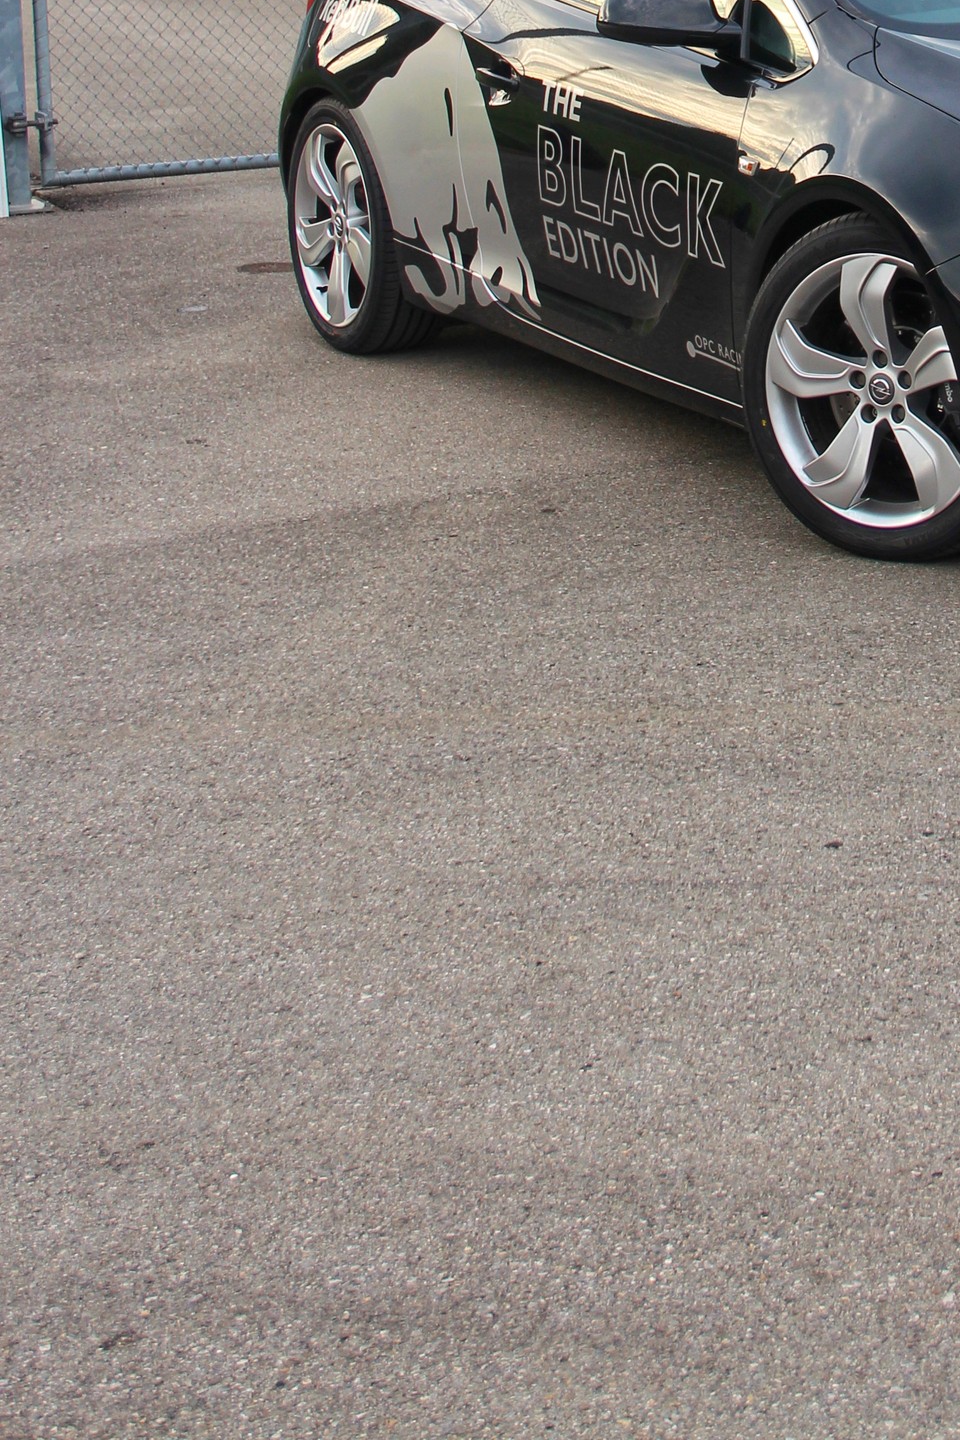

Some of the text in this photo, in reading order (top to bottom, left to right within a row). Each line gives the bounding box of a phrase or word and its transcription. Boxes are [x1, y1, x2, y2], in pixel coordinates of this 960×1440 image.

[542, 79, 584, 122] THE
[537, 124, 726, 269] BLACK
[543, 215, 660, 300] EDITION
[694, 334, 716, 354] OPC
